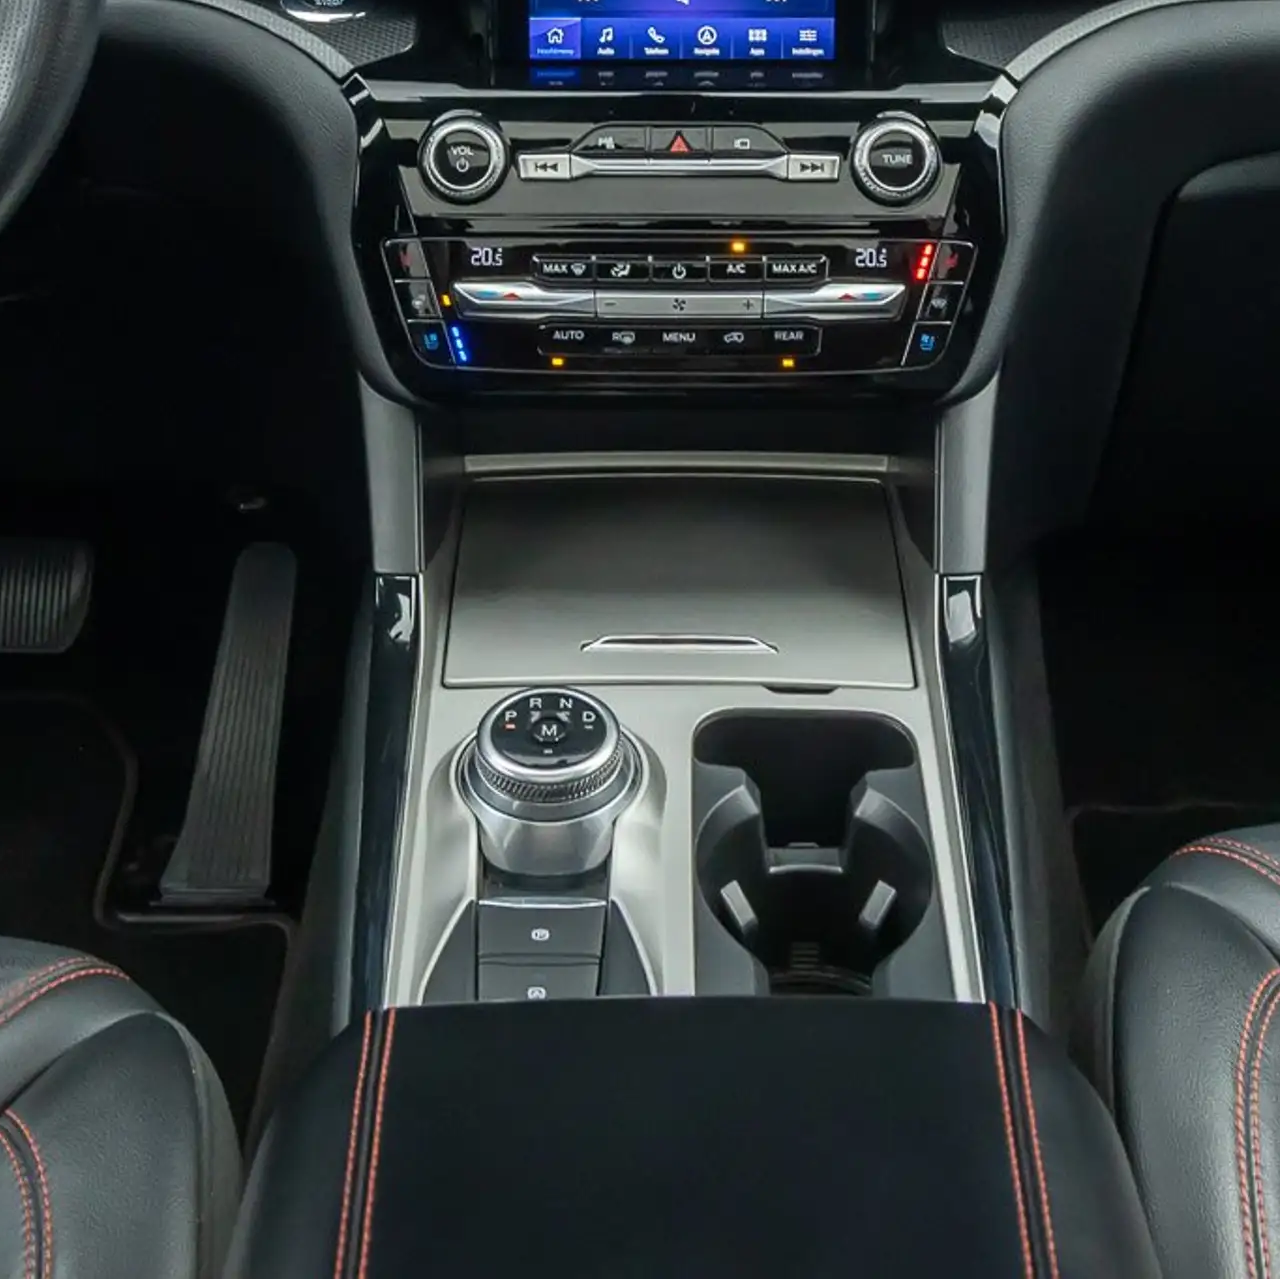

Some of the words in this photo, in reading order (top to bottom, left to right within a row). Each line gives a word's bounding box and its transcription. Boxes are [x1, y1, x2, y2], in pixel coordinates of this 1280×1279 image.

[450, 145, 474, 157] VOL
[881, 153, 913, 165] TUNE
[542, 262, 569, 274] MAX
[726, 263, 747, 274] A/C
[771, 263, 797, 274] MAX
[797, 263, 818, 274] A/C
[552, 330, 586, 340] AUTO
[662, 331, 696, 343] MENU
[773, 330, 805, 341] REAR
[529, 697, 542, 709] R
[559, 697, 573, 709] N
[504, 709, 518, 722] P
[582, 710, 597, 723] D
[541, 723, 557, 737] M
